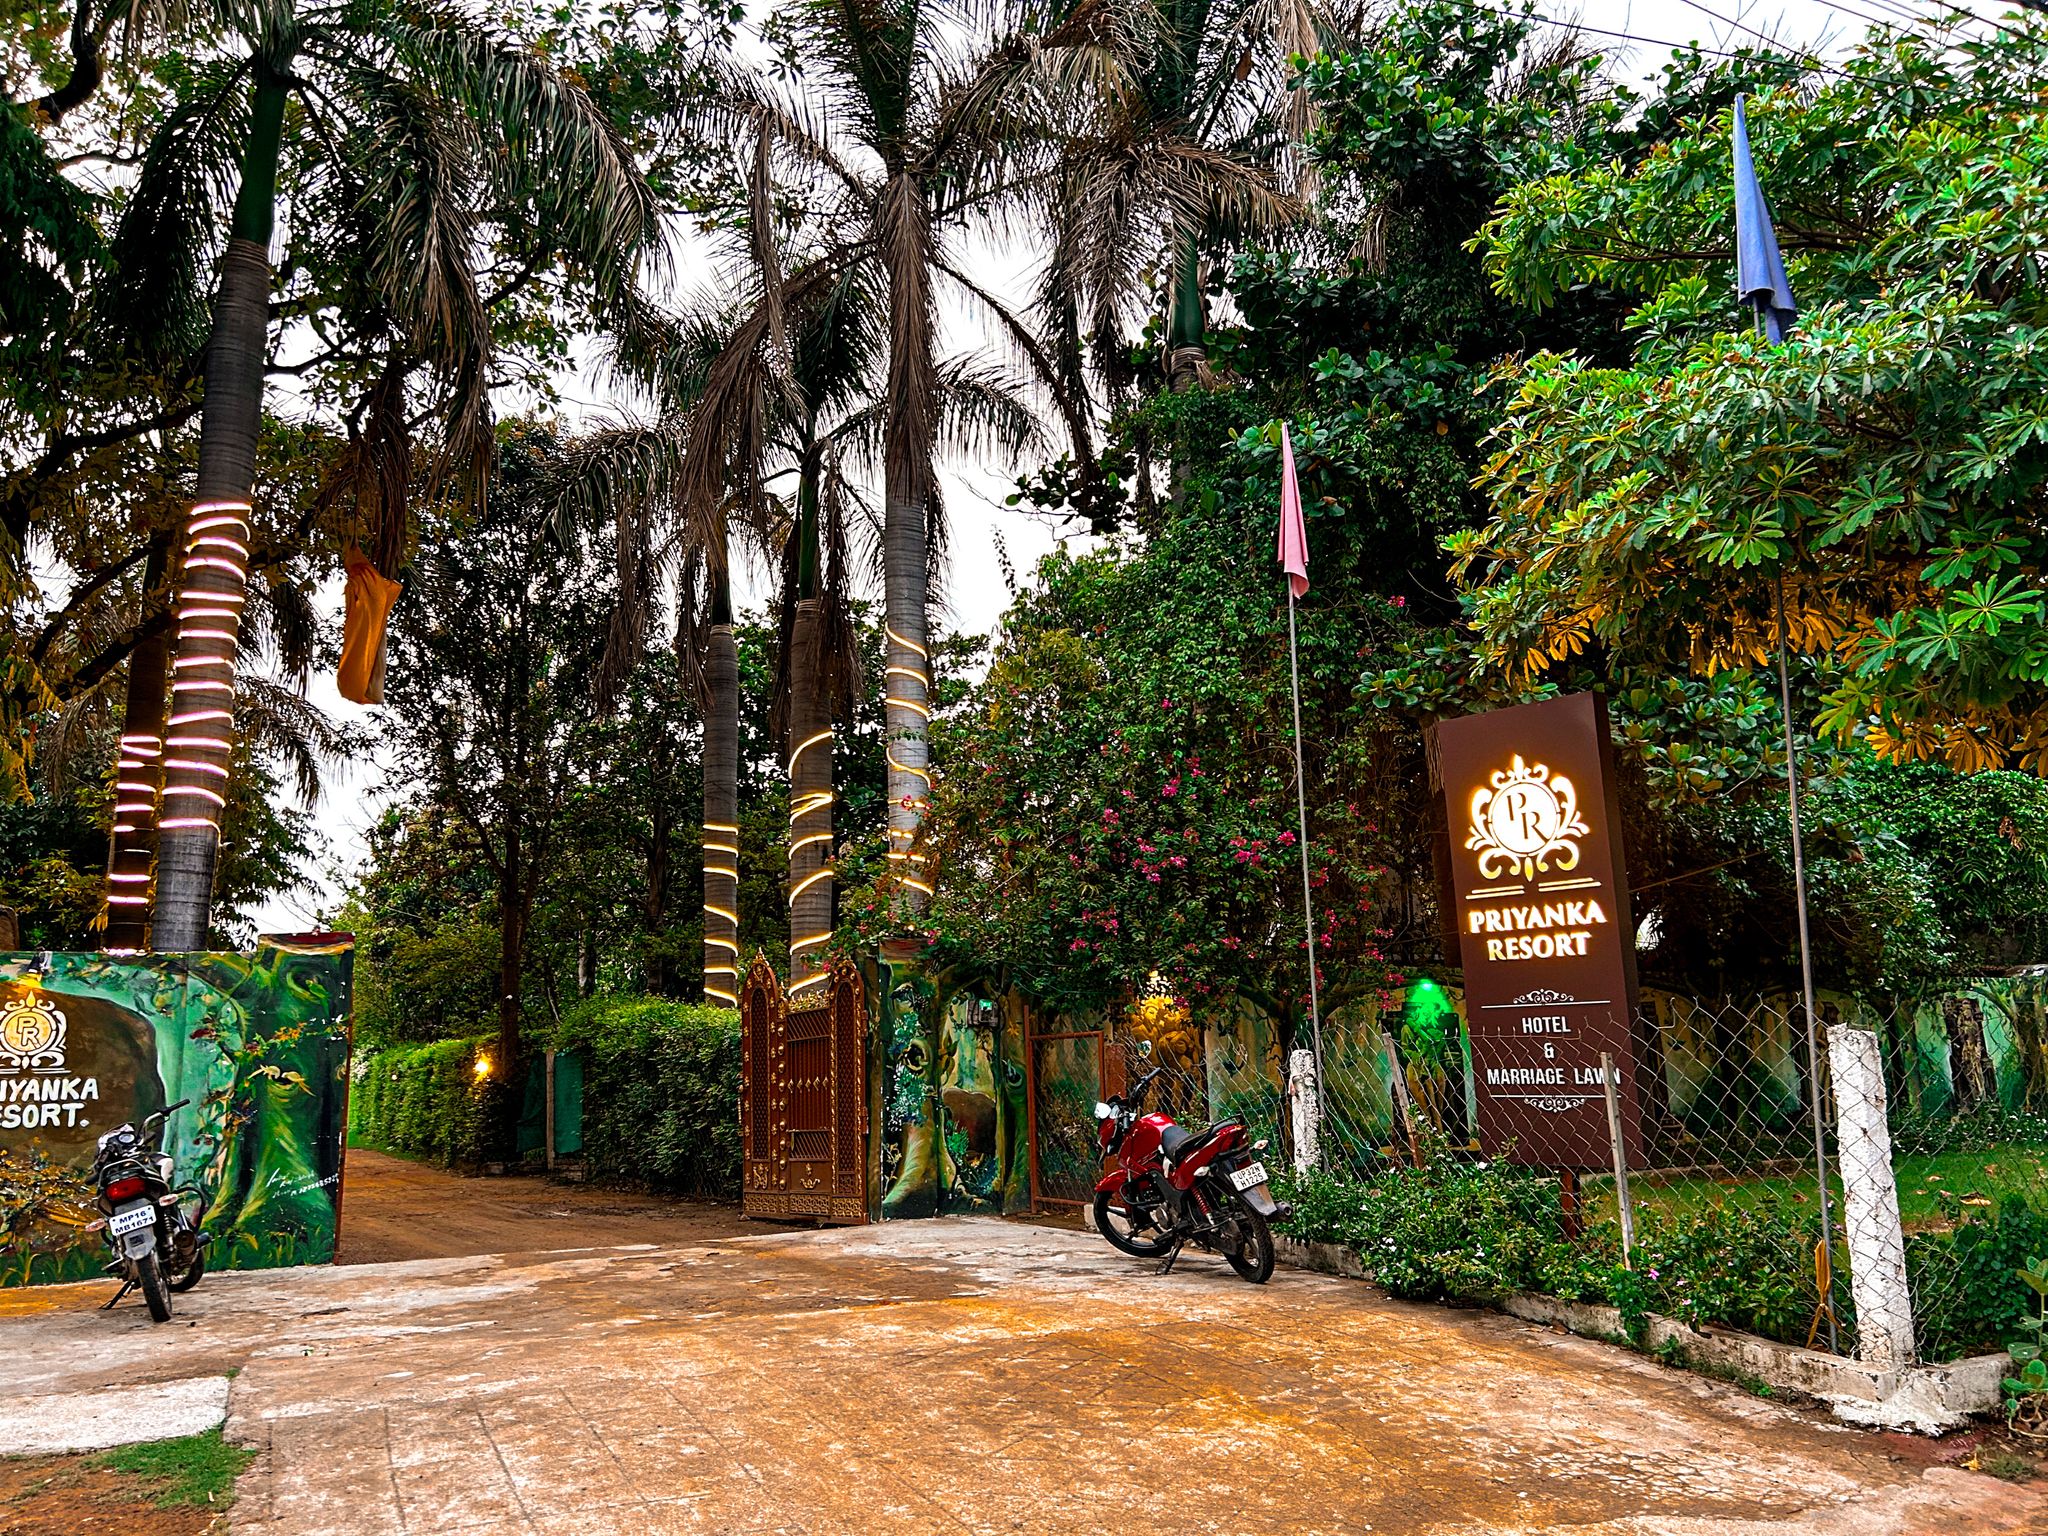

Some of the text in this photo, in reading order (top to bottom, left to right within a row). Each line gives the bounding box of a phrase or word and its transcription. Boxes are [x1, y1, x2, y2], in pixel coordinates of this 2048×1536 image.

[1468, 900, 1607, 934] PRIYANKA
[1487, 931, 1592, 962] RESORT
[1522, 1016, 1571, 1034] HOTEL
[1543, 1042, 1555, 1059] &
[1487, 1067, 1565, 1085] MARRIAGE
[0, 1077, 99, 1102] IYANKA
[0, 1102, 90, 1129] SORT.
[115, 1216, 154, 1234] MB1671
[119, 1210, 147, 1224] MP16
